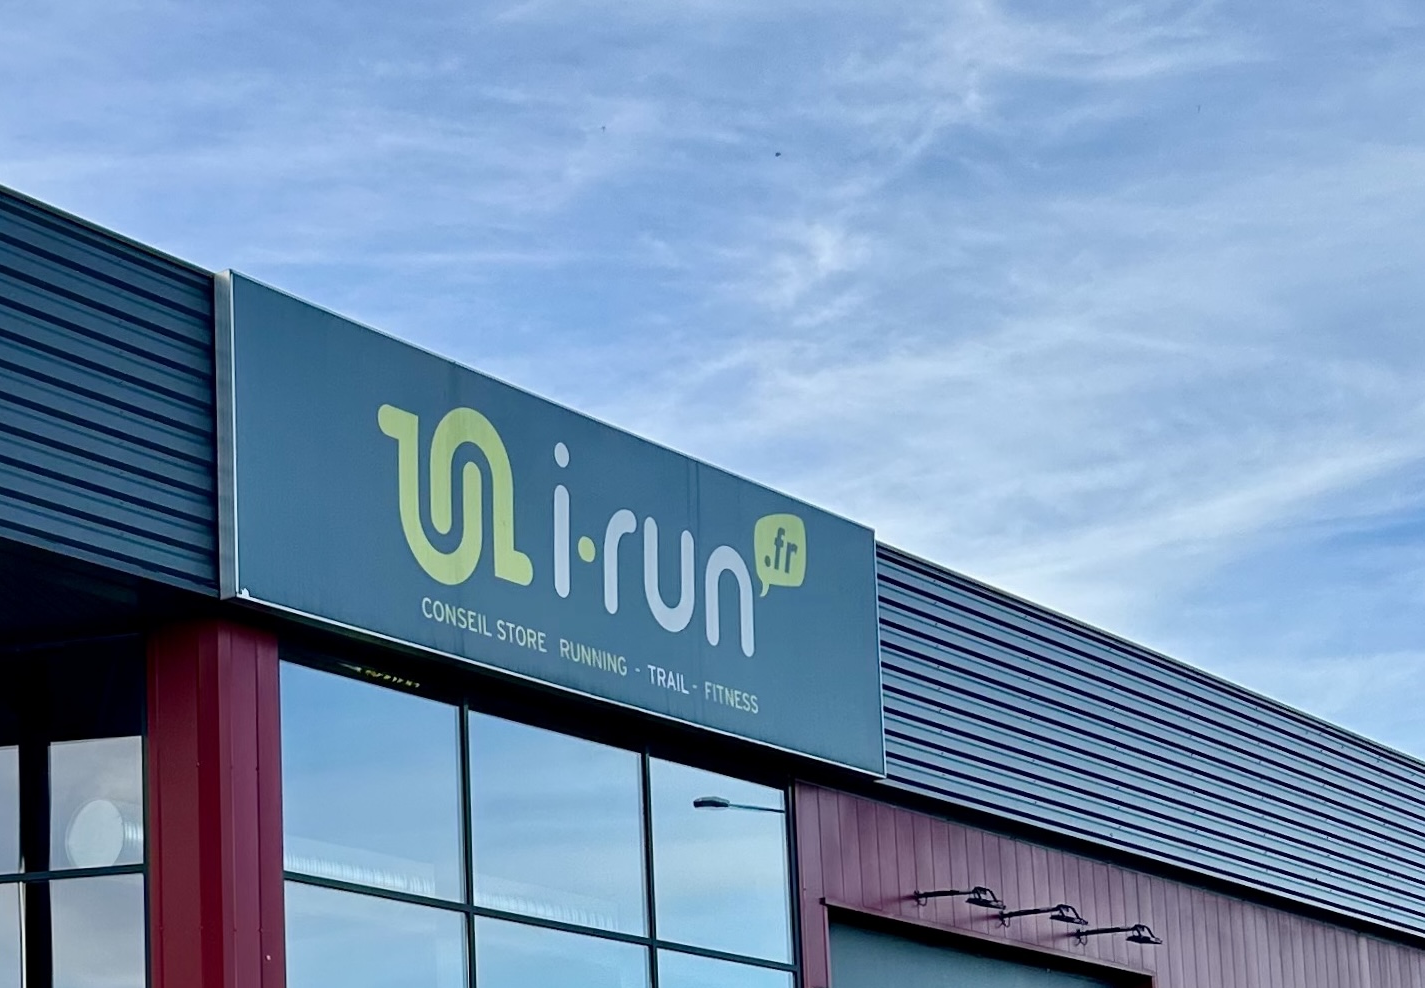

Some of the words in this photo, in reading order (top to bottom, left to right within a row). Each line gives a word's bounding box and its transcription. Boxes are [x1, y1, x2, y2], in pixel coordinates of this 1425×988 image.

[422, 596, 493, 637] CONSEIL
[496, 619, 548, 653] STORE
[560, 638, 628, 676] RUNNING
[647, 664, 690, 694] TRAIL
[704, 681, 760, 714] FITNESS
